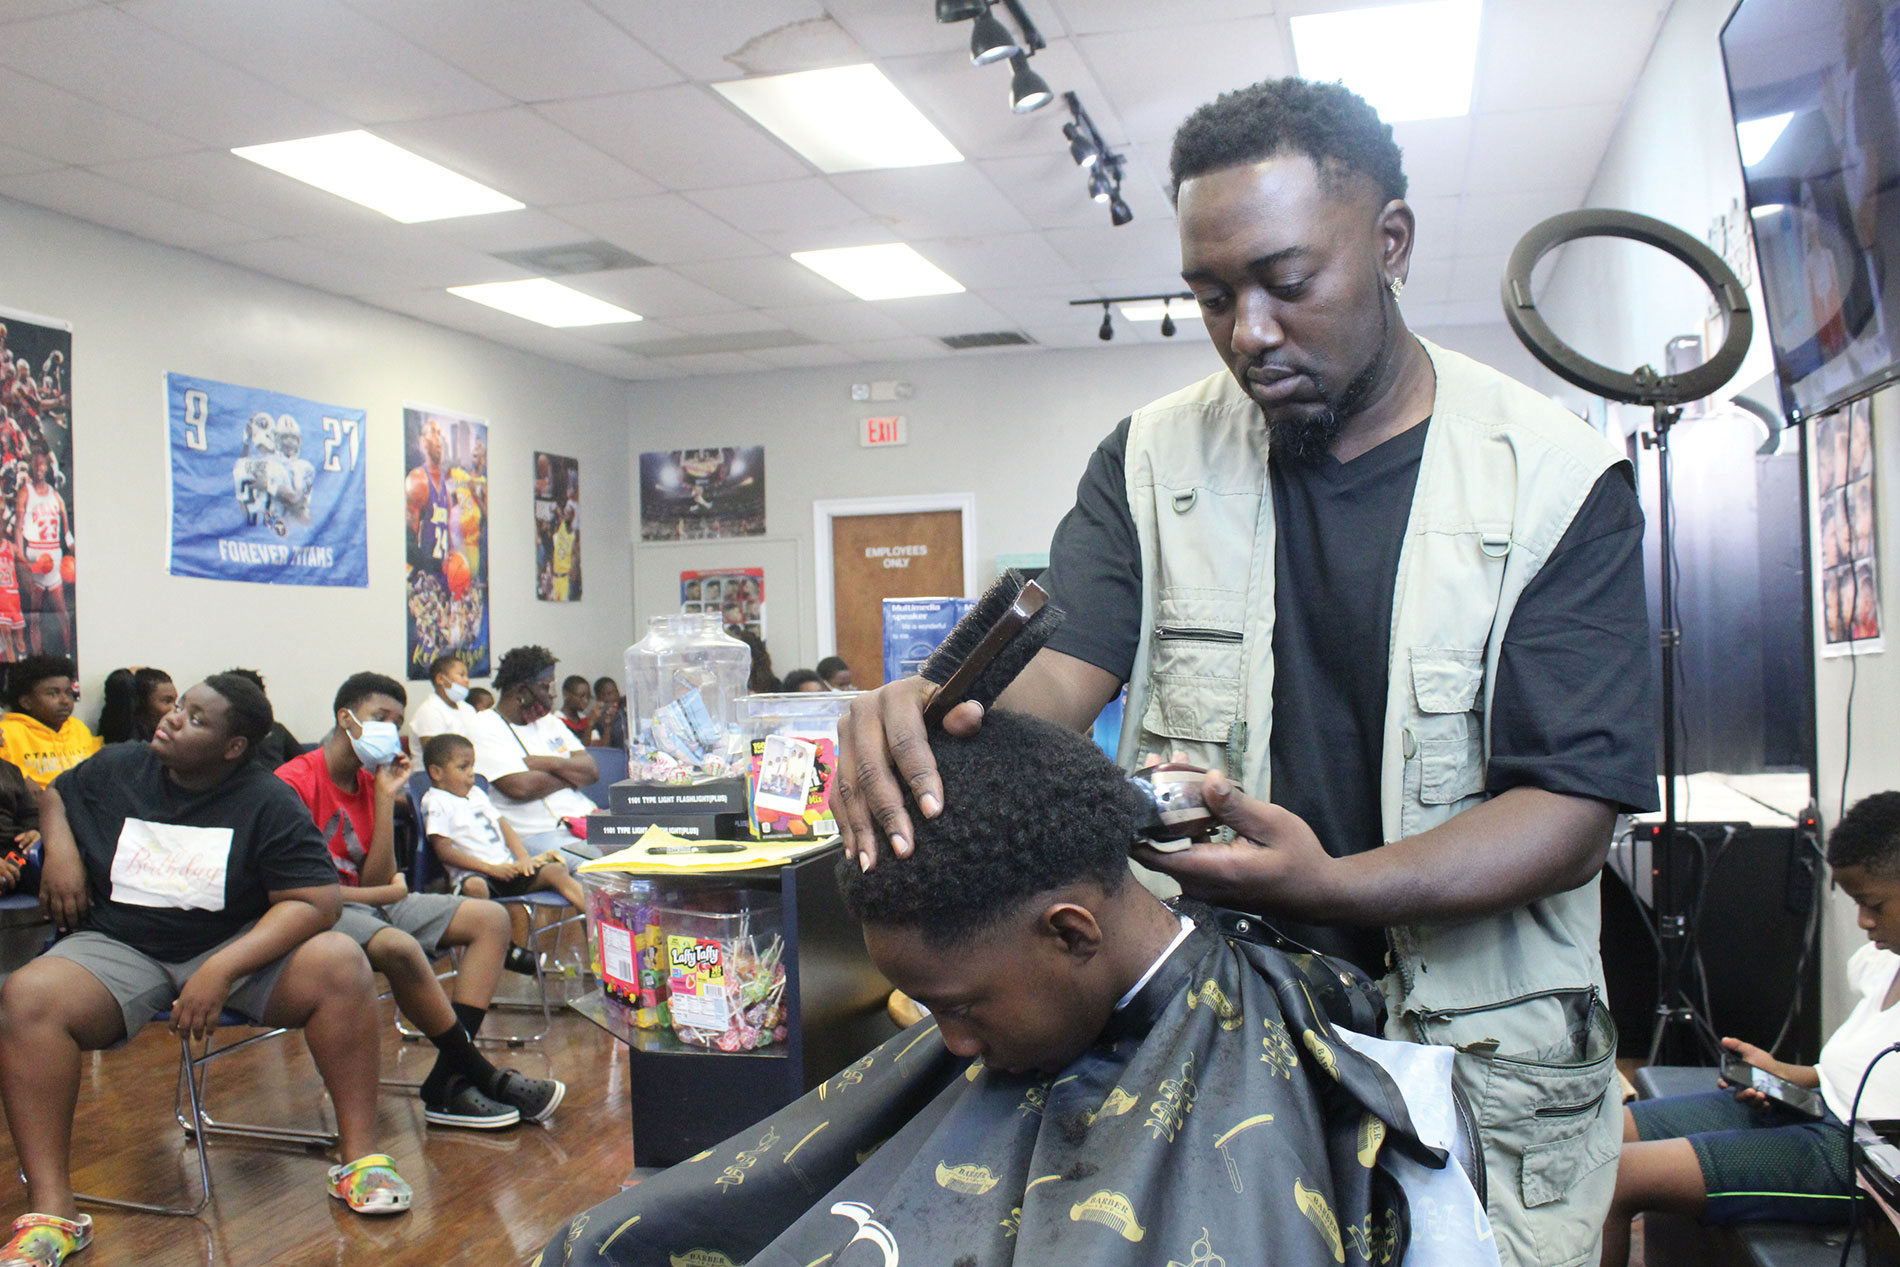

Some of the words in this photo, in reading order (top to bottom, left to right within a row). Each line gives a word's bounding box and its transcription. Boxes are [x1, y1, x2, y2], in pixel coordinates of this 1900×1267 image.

[184, 389, 208, 451] 9
[322, 416, 360, 472] 27
[868, 417, 898, 443] EXIT
[37, 518, 58, 541] 23
[218, 539, 289, 566] FOREVER
[290, 546, 334, 568] TITANS
[865, 545, 928, 557] EMPLOYEES
[883, 558, 909, 568] ONLY
[891, 604, 941, 612] Multimedia
[891, 613, 928, 621] speaker
[628, 796, 641, 804] 1101
[642, 796, 656, 804] TYPE
[658, 795, 675, 803] LIGHT
[474, 811, 500, 844] 3
[603, 827, 616, 835] 1101
[671, 946, 697, 967] Laffy
[695, 944, 719, 965] Taffy
[1090, 1197, 1128, 1214] BARBER
[690, 1253, 724, 1263] BARBER
